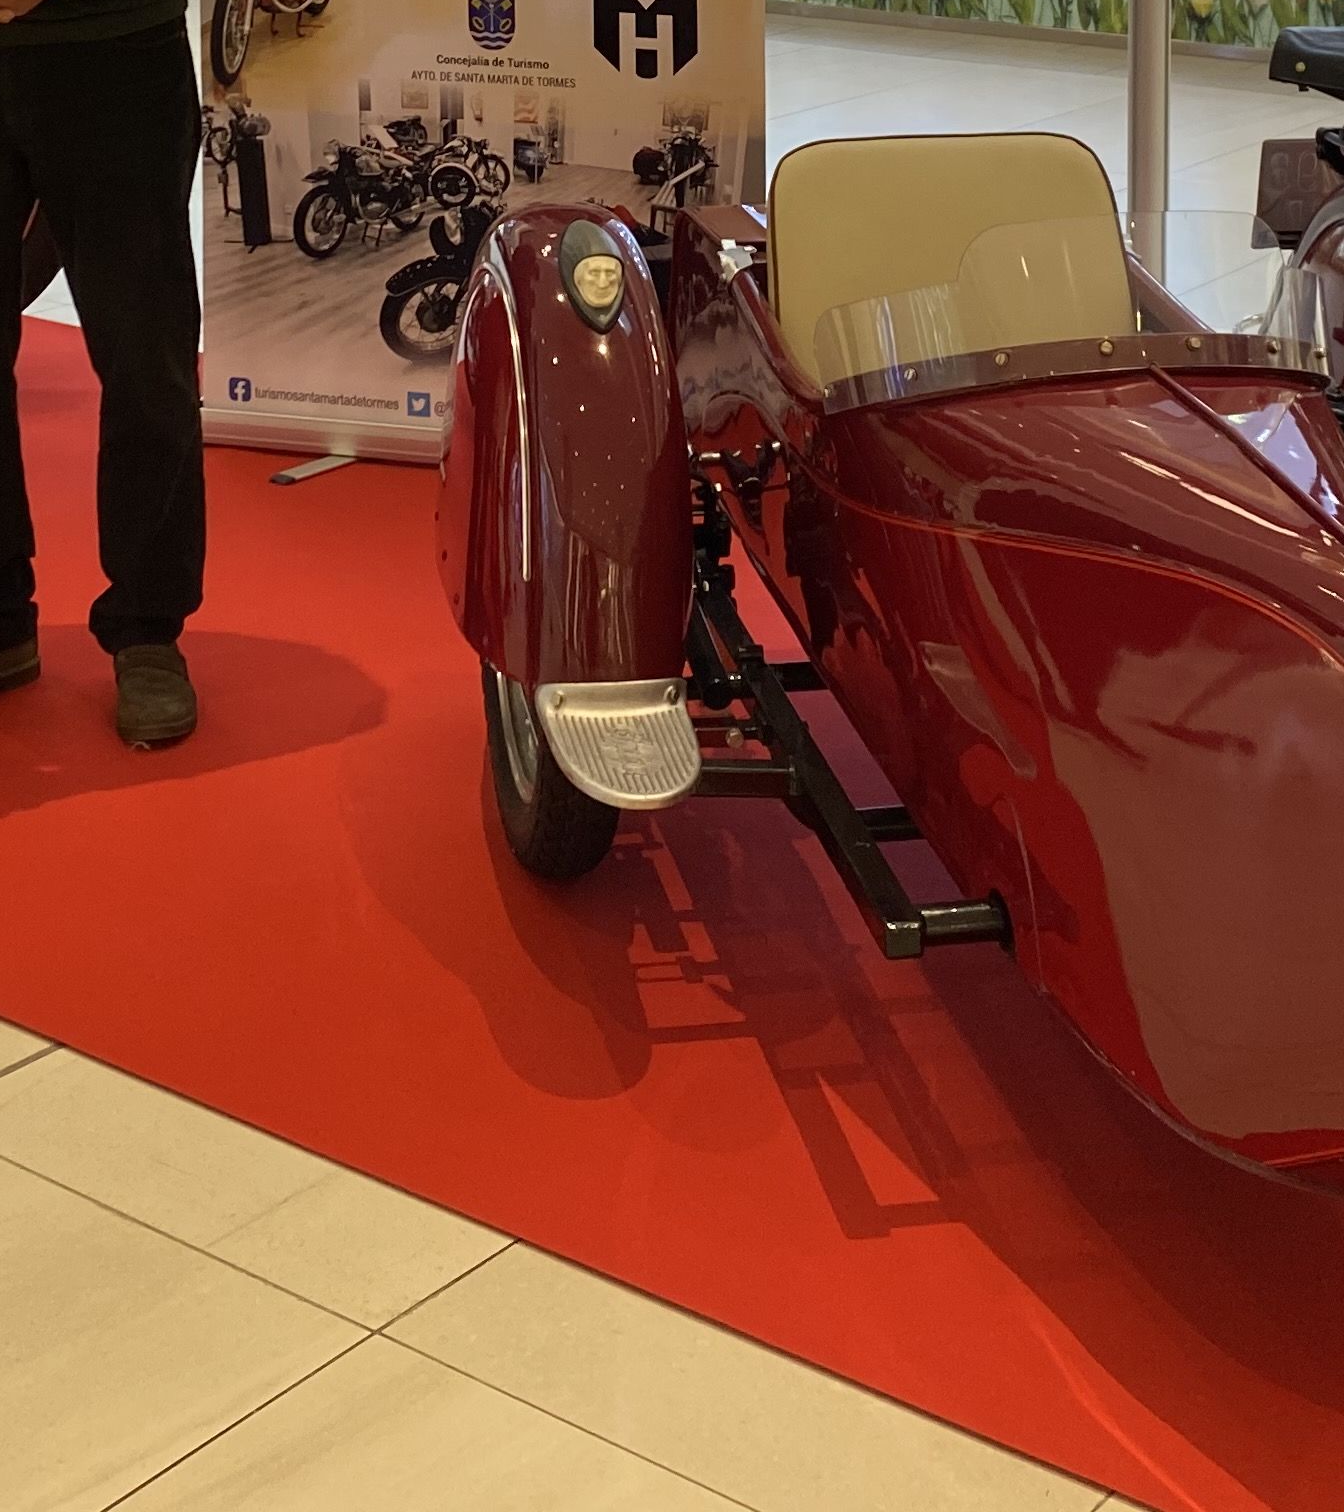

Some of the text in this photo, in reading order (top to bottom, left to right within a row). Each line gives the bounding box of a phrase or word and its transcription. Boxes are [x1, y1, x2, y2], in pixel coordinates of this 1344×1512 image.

[491, 57, 505, 68] de
[507, 57, 550, 71] Turismo
[411, 70, 577, 88] AYTO. DE SANTA MARTA DE TORMES
[254, 386, 400, 411] turismosantamartadetormes
